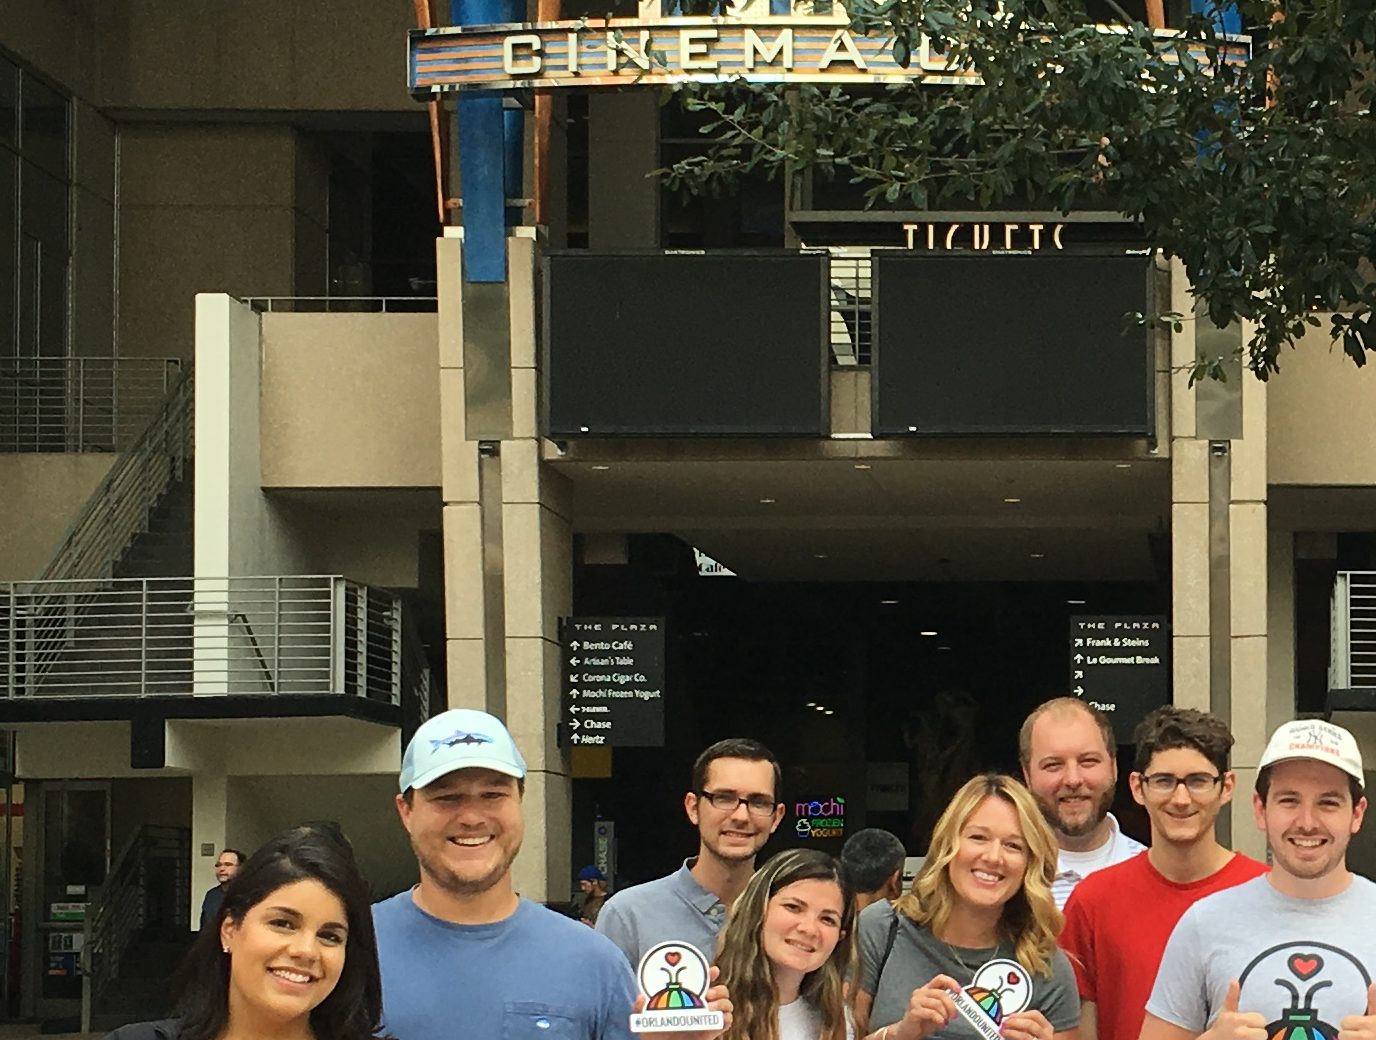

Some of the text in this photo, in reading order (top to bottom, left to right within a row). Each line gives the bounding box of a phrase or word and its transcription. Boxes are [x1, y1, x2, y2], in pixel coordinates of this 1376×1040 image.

[503, 28, 868, 75] CINEMA
[582, 640, 634, 650] Bento Café
[1086, 637, 1112, 647] Frank
[1122, 637, 1150, 647] Steins
[1086, 655, 1160, 665] Le Gourmet Break
[582, 673, 611, 683] Corona
[582, 689, 661, 701] Mochi Frozen Yogurt
[583, 719, 612, 729] Chase
[580, 735, 606, 744] Hertz
[796, 797, 845, 816] mochi
[635, 1014, 719, 1028] #ORLANDOUNITED
